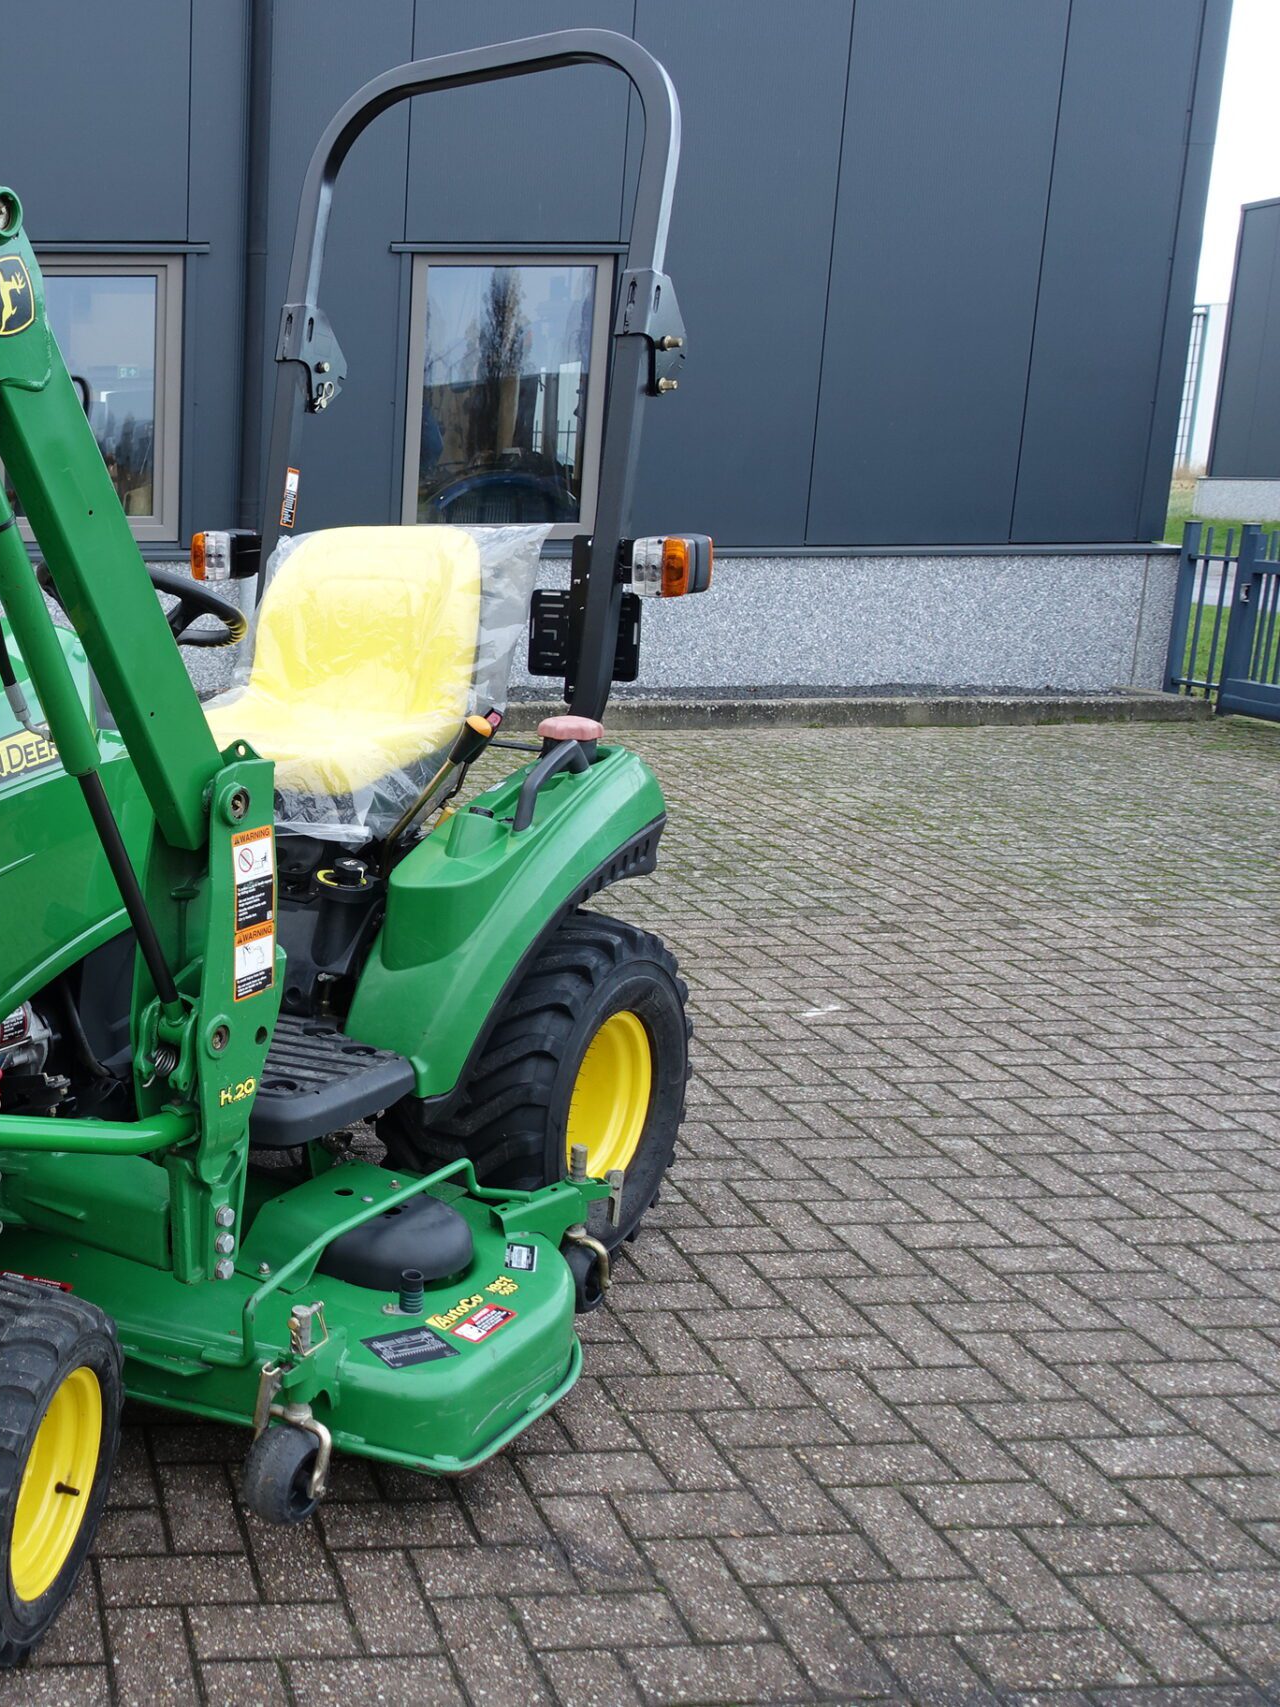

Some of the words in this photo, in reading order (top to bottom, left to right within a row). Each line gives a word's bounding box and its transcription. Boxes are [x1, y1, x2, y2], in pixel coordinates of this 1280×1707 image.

[6, 739, 60, 770] DEER
[240, 828, 270, 842] WARNING
[242, 925, 273, 942] WARNING
